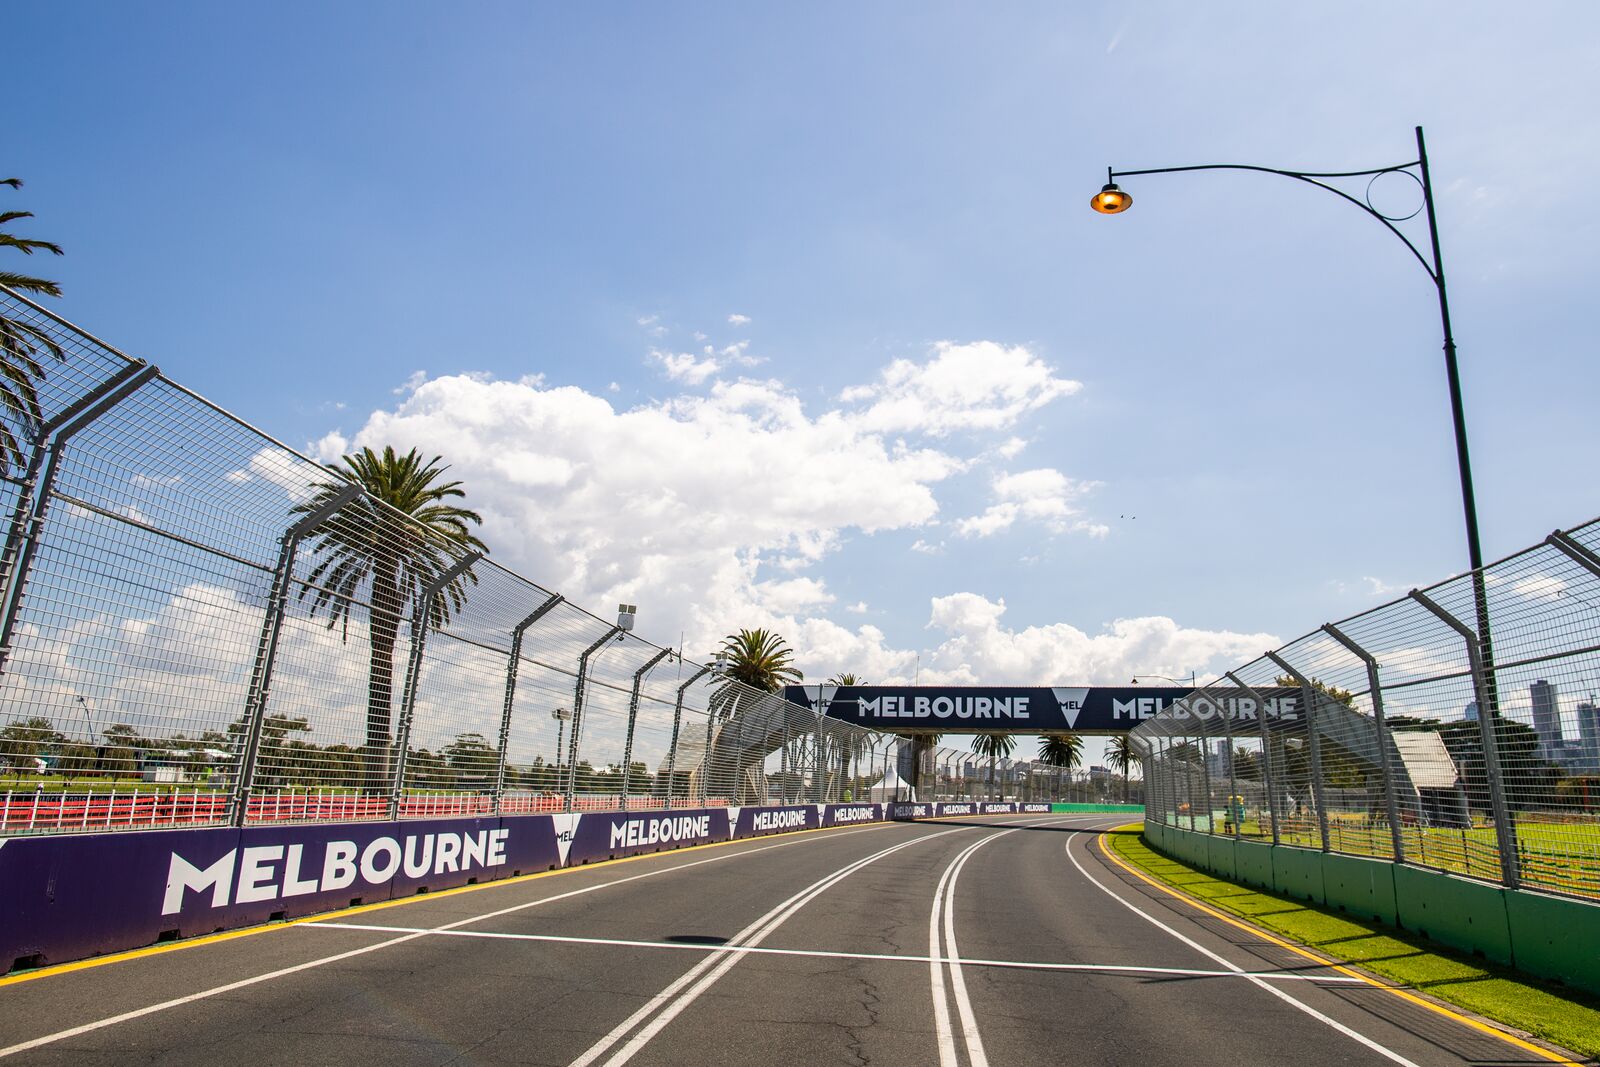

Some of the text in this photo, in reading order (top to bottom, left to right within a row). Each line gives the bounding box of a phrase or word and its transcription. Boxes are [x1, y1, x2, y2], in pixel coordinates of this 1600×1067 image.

[858, 696, 1030, 719] MELBOURNE
[1058, 700, 1082, 710] MEL
[1113, 697, 1298, 720] MELBOURNE
[753, 809, 807, 831] MELBOURNE
[834, 807, 874, 822] MELBOURNE
[894, 805, 926, 817] MELBOURNE
[555, 830, 574, 843] MEL
[609, 815, 711, 849] MELBOURNE
[161, 828, 510, 916] MELBOURNE
